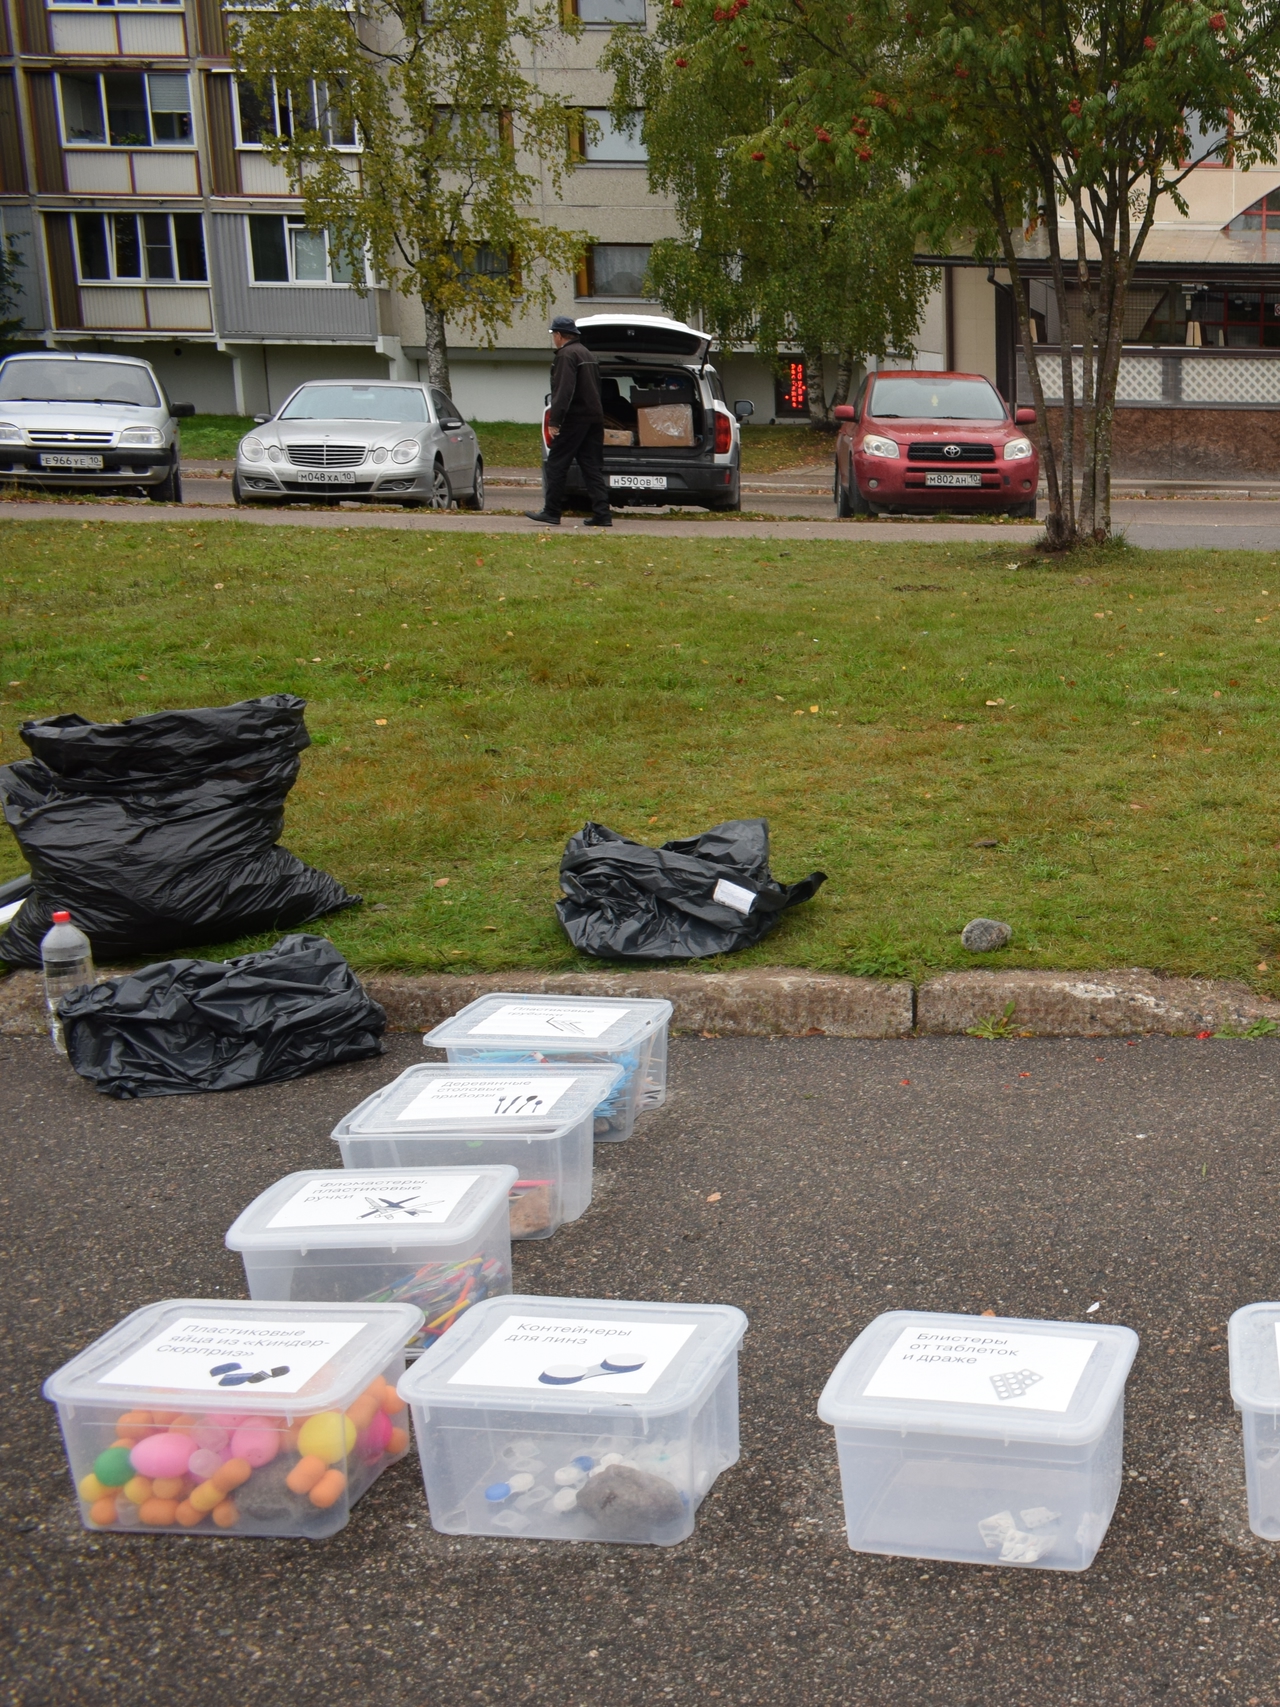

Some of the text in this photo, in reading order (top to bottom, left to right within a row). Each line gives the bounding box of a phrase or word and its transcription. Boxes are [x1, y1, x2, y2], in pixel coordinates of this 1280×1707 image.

[512, 1006, 595, 1014] Пластиковые
[312, 1185, 422, 1195] пластиковые
[303, 1193, 354, 1203] ручки
[182, 1324, 306, 1337] Пластиковые
[516, 1323, 633, 1337] Контейнеры
[168, 1334, 214, 1346] яйца
[216, 1338, 240, 1346] из
[504, 1332, 588, 1345] для линз
[916, 1332, 1009, 1346] Блистеры
[909, 1342, 1020, 1357] от таблеток
[902, 1353, 978, 1365] и драже
